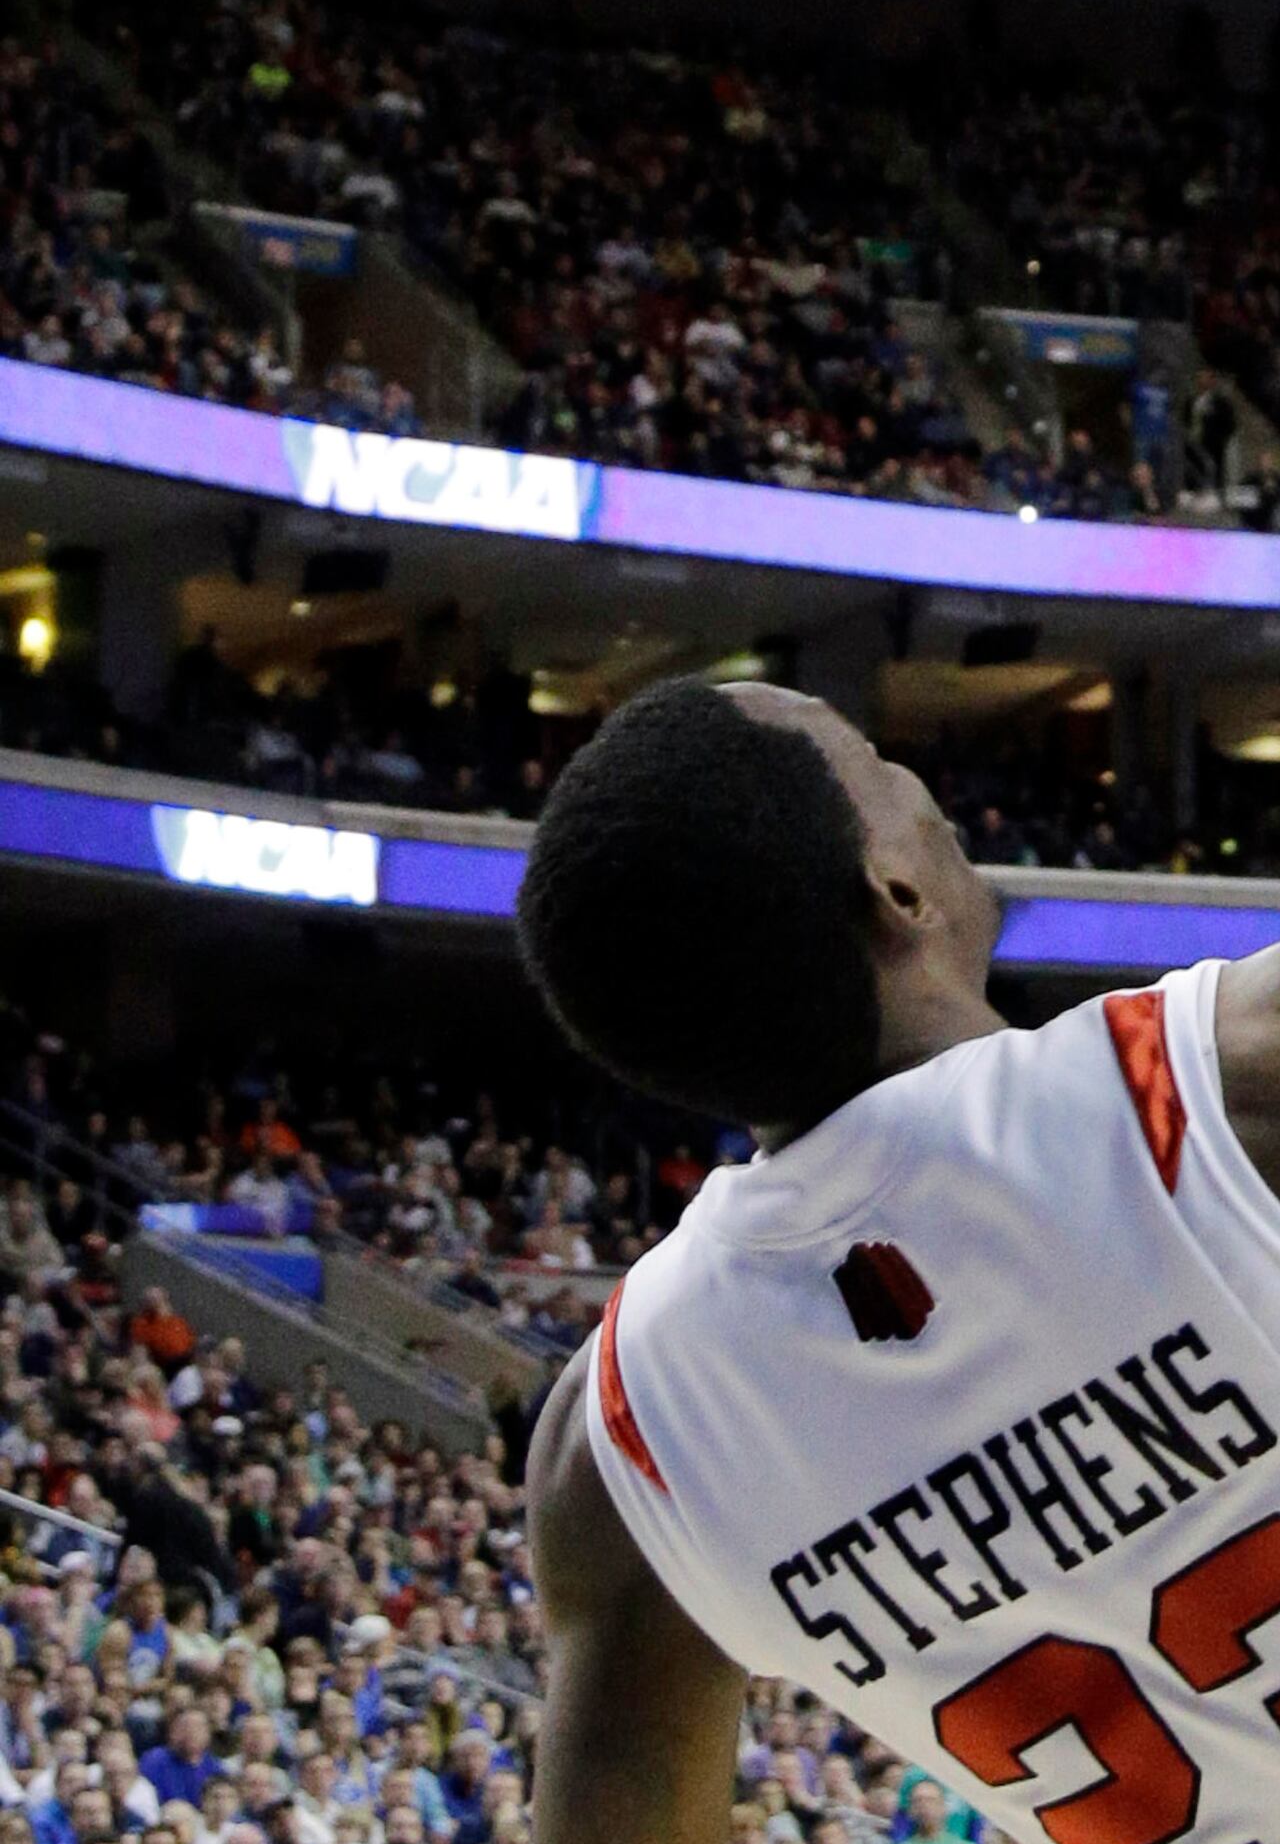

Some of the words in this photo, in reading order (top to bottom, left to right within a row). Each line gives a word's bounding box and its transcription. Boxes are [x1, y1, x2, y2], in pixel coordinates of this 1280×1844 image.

[302, 420, 582, 541] NCAA
[178, 808, 377, 906] NCAA
[770, 1322, 1277, 1688] STEPHENS
